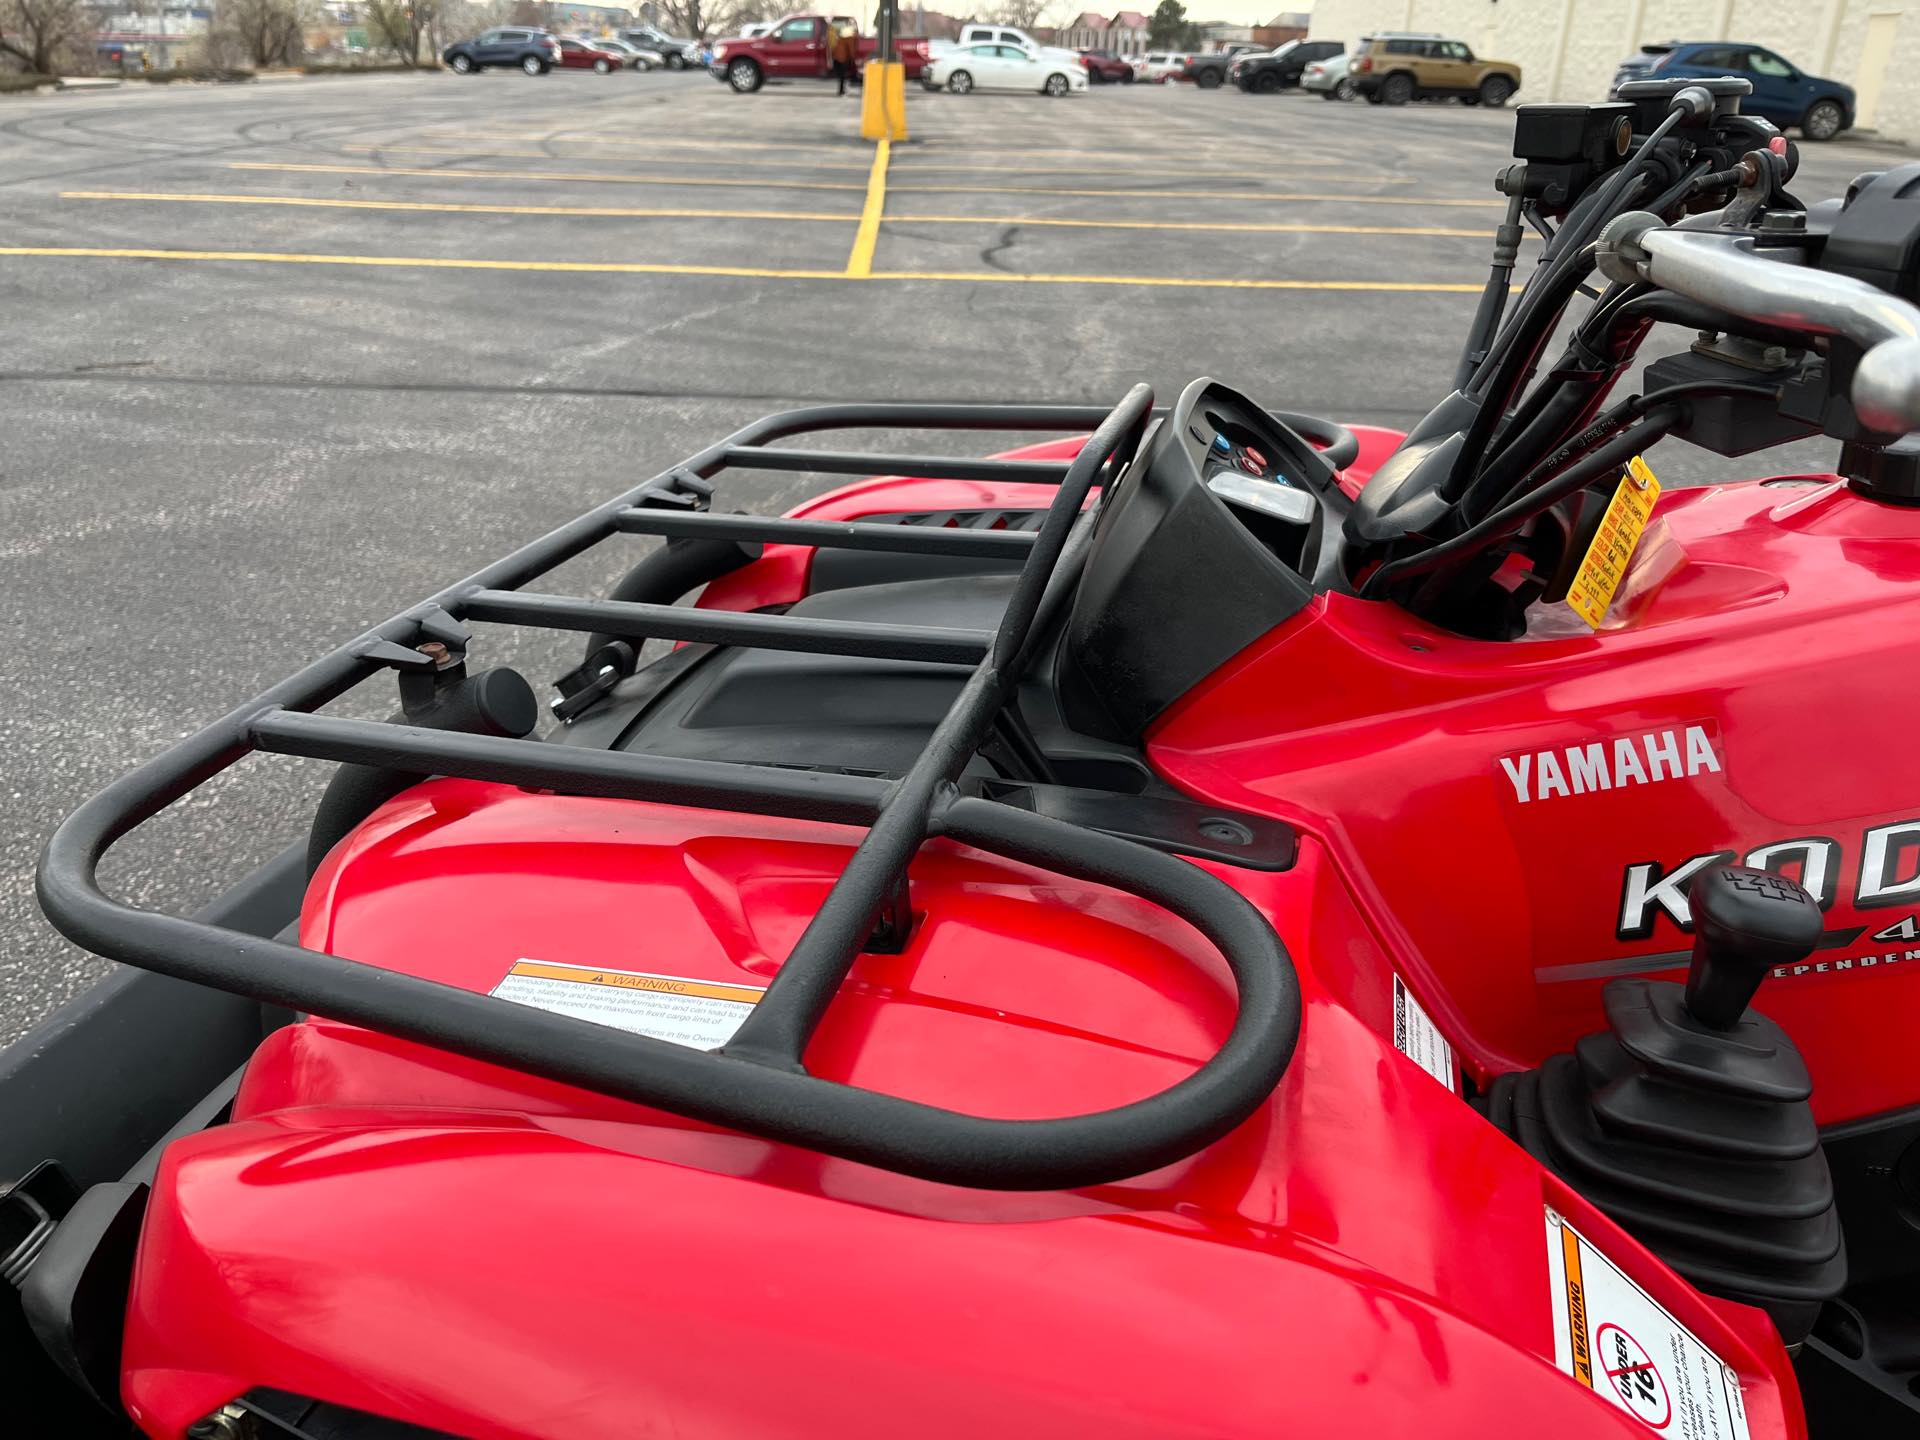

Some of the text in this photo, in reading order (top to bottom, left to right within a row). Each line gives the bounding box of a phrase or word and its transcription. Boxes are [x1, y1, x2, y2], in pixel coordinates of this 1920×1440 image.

[1500, 725, 1721, 803] YAMAHA
[613, 976, 686, 992] WARNING
[1570, 1280, 1587, 1359] WARNING
[1670, 1332, 1680, 1364] under
[1677, 1333, 1688, 1370] chance
[1615, 1332, 1632, 1400] UNDER
[1675, 1365, 1683, 1384] are
[1700, 1356, 1709, 1374] are
[1632, 1360, 1657, 1406] 16
[1678, 1384, 1688, 1408] you
[1684, 1371, 1694, 1398] your
[1704, 1374, 1714, 1398] you
[1708, 1404, 1719, 1430] ATV
